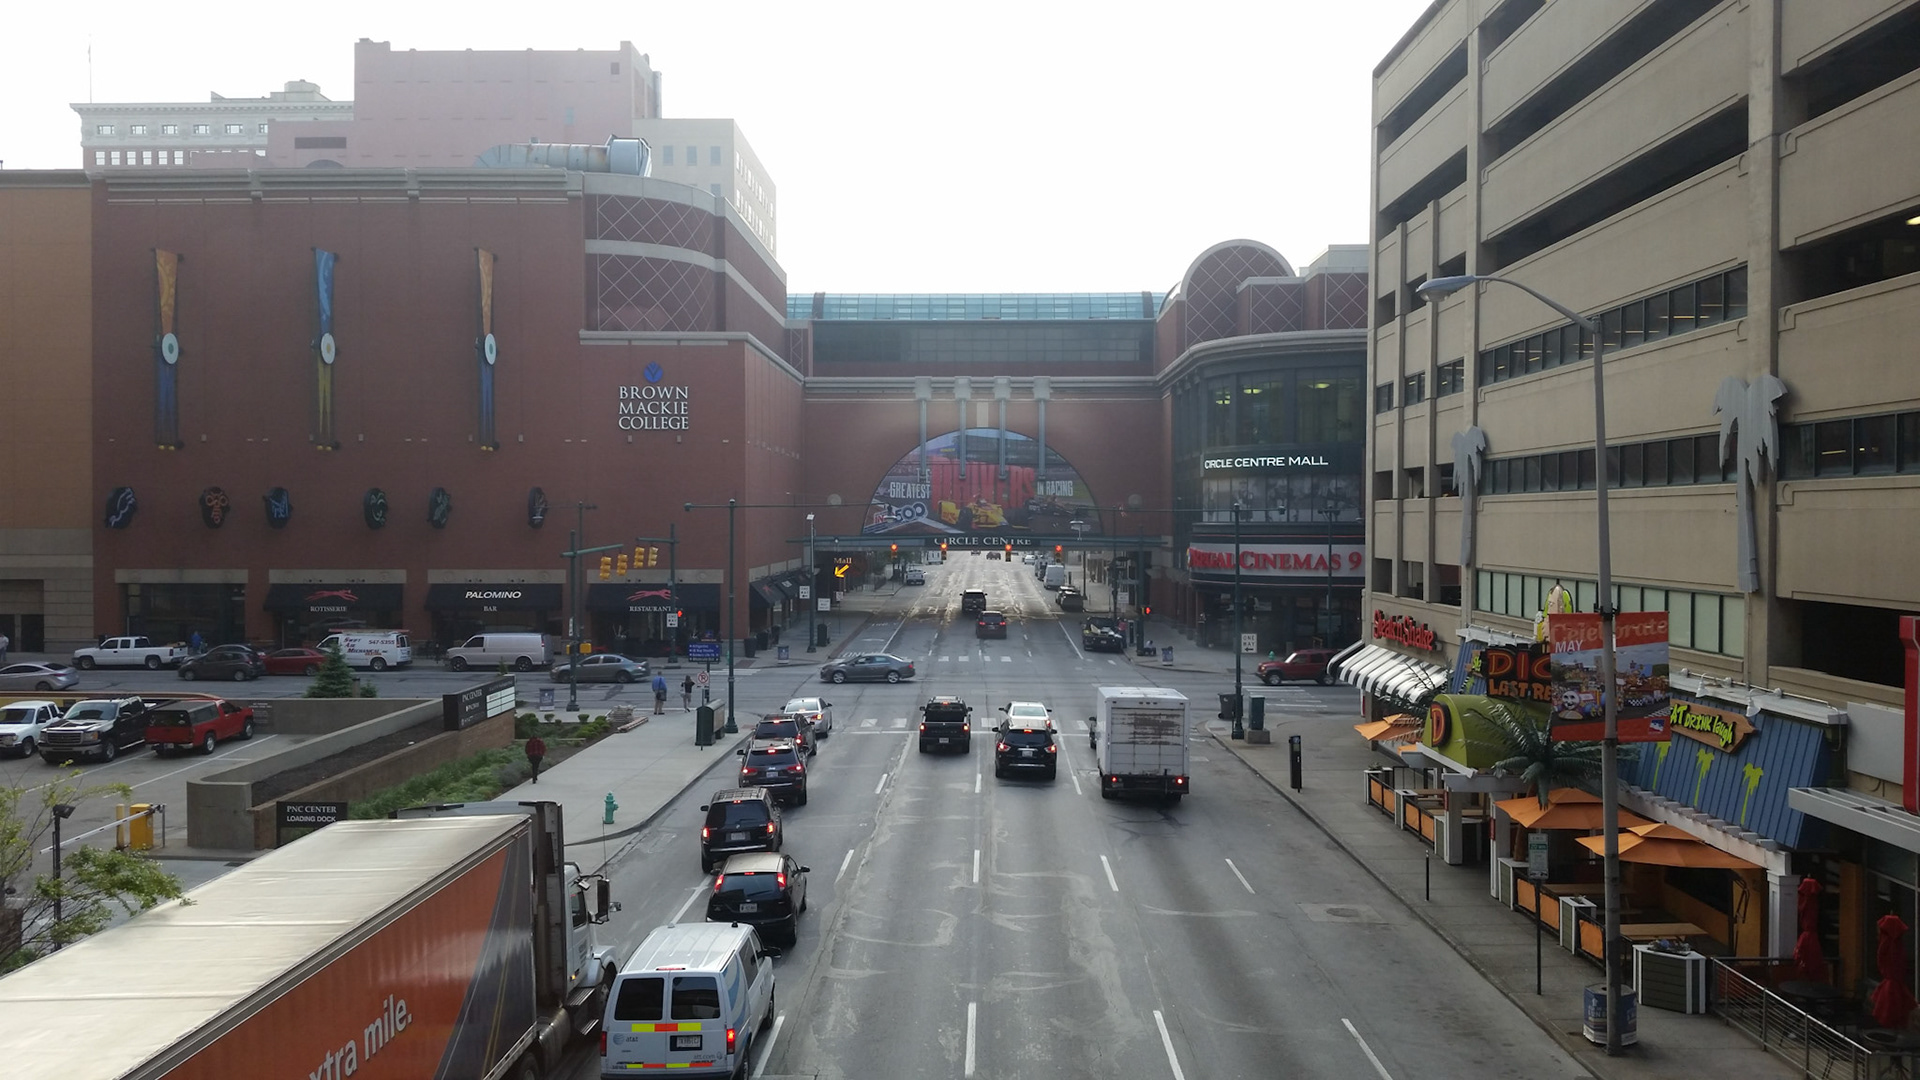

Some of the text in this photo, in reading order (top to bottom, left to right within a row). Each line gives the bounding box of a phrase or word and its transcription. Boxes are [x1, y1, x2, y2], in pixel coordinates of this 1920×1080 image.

[619, 385, 689, 399] BROWN
[618, 401, 689, 415] MACKIE
[618, 416, 689, 430] COLLEGE
[1204, 456, 1329, 469] CIRCLE CENTRE MALL
[917, 468, 930, 483] TE
[931, 454, 1035, 512] DRIVERS
[889, 482, 930, 499] GREATEST
[1046, 480, 1074, 497] RACING
[934, 536, 1032, 546] CIRCLE CENTRE
[1239, 550, 1341, 571] CINEMAS
[1348, 551, 1362, 570] 9
[465, 591, 522, 599] PALOMINO
[1403, 615, 1434, 650] Shake
[1555, 639, 1583, 653] MAY
[1486, 651, 1552, 681] DIC
[1488, 679, 1552, 701] LAST RE
[1670, 704, 1733, 748] AT DRINK laugh
[286, 805, 304, 813] PNC
[309, 994, 412, 1080] xtra mile.
[625, 1035, 639, 1043] at&t
